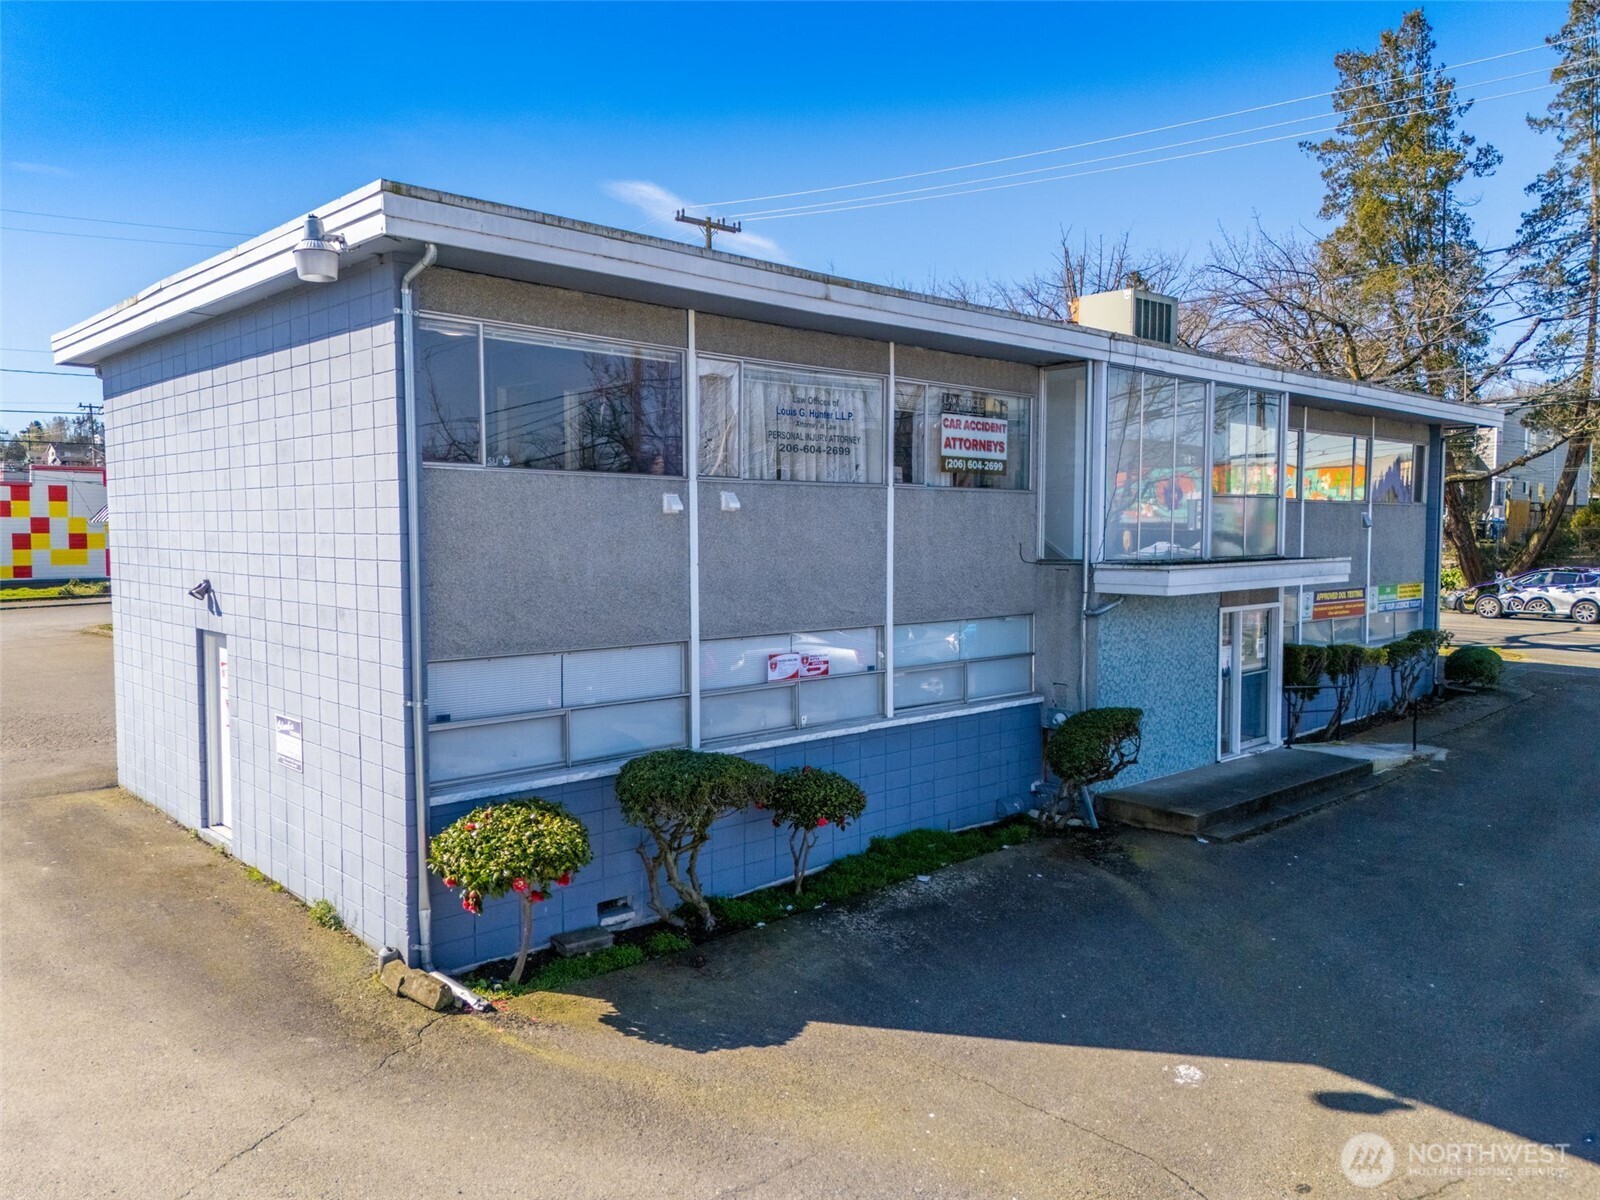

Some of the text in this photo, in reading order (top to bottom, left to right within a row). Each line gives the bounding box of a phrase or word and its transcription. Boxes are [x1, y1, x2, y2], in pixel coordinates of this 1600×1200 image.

[792, 395, 839, 407] Law Offices of
[776, 405, 854, 421] Louis G. Hunter L.L.P.
[795, 420, 818, 430] Attorney
[943, 418, 1007, 434] CAR ACCIDENT
[768, 430, 861, 444] PERSONAL INJURY ATTORNEY
[779, 443, 850, 455] 206-604-2699
[944, 437, 1005, 453] ATTORNEYS
[945, 459, 1003, 471] (206) 604-2699
[1317, 592, 1338, 601] APPROVED
[1347, 590, 1363, 598] TESTING
